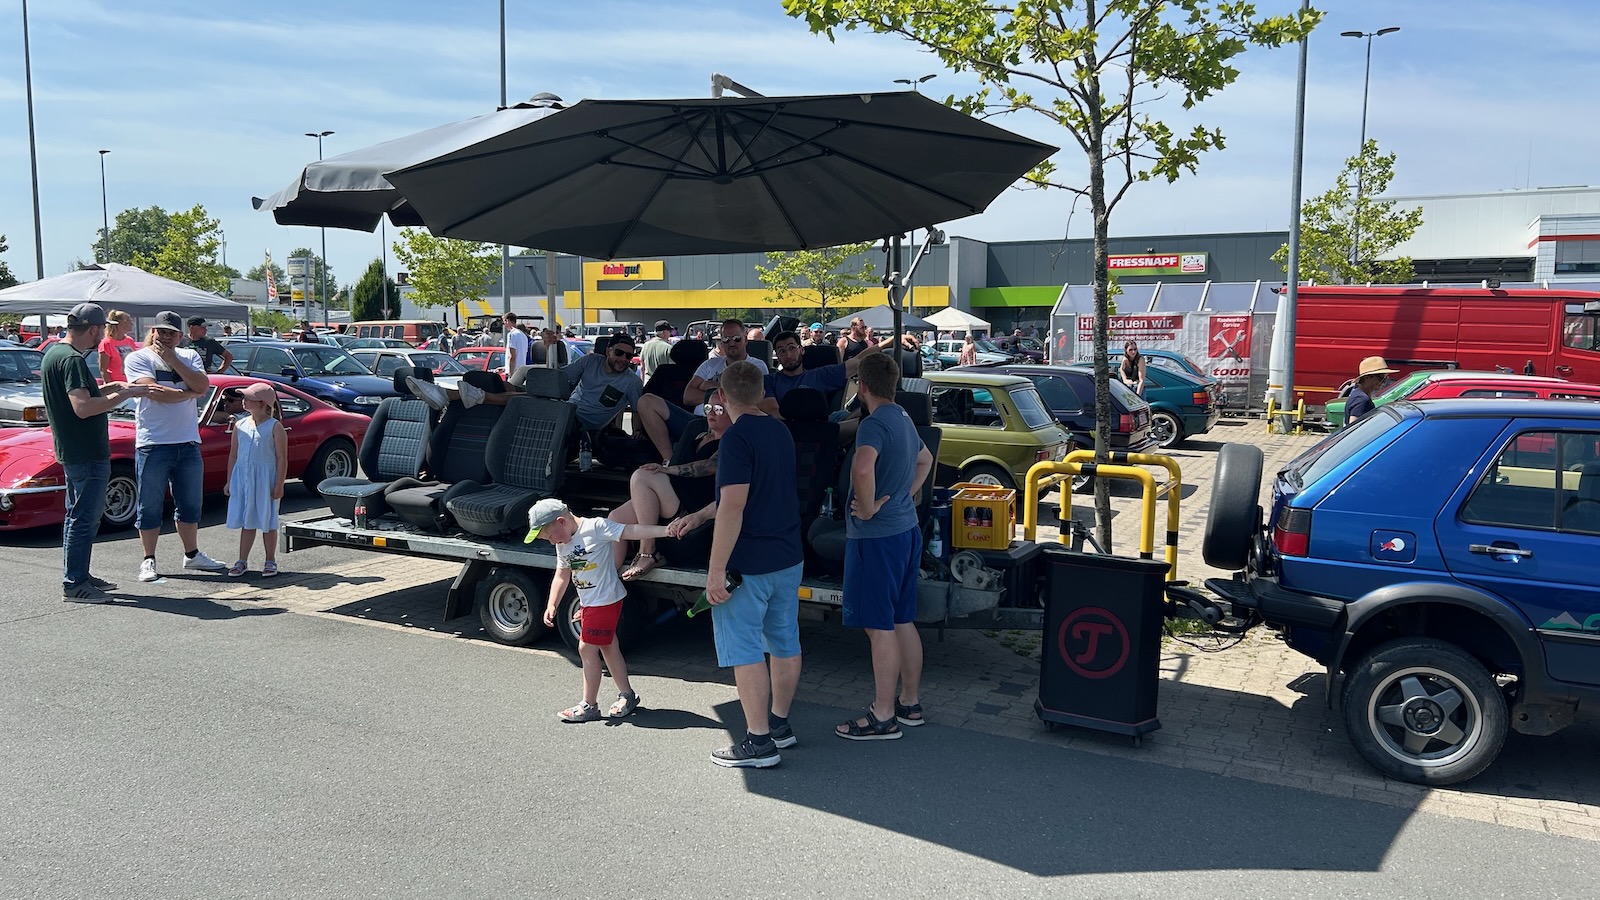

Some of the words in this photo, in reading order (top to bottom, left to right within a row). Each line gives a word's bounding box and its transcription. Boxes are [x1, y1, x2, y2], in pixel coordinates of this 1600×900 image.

[1109, 257, 1178, 267] FRESSNAPF
[1080, 318, 1094, 329] Hi
[1109, 318, 1148, 329] bauen
[1151, 317, 1175, 328] wir.
[967, 532, 991, 541] Coke
